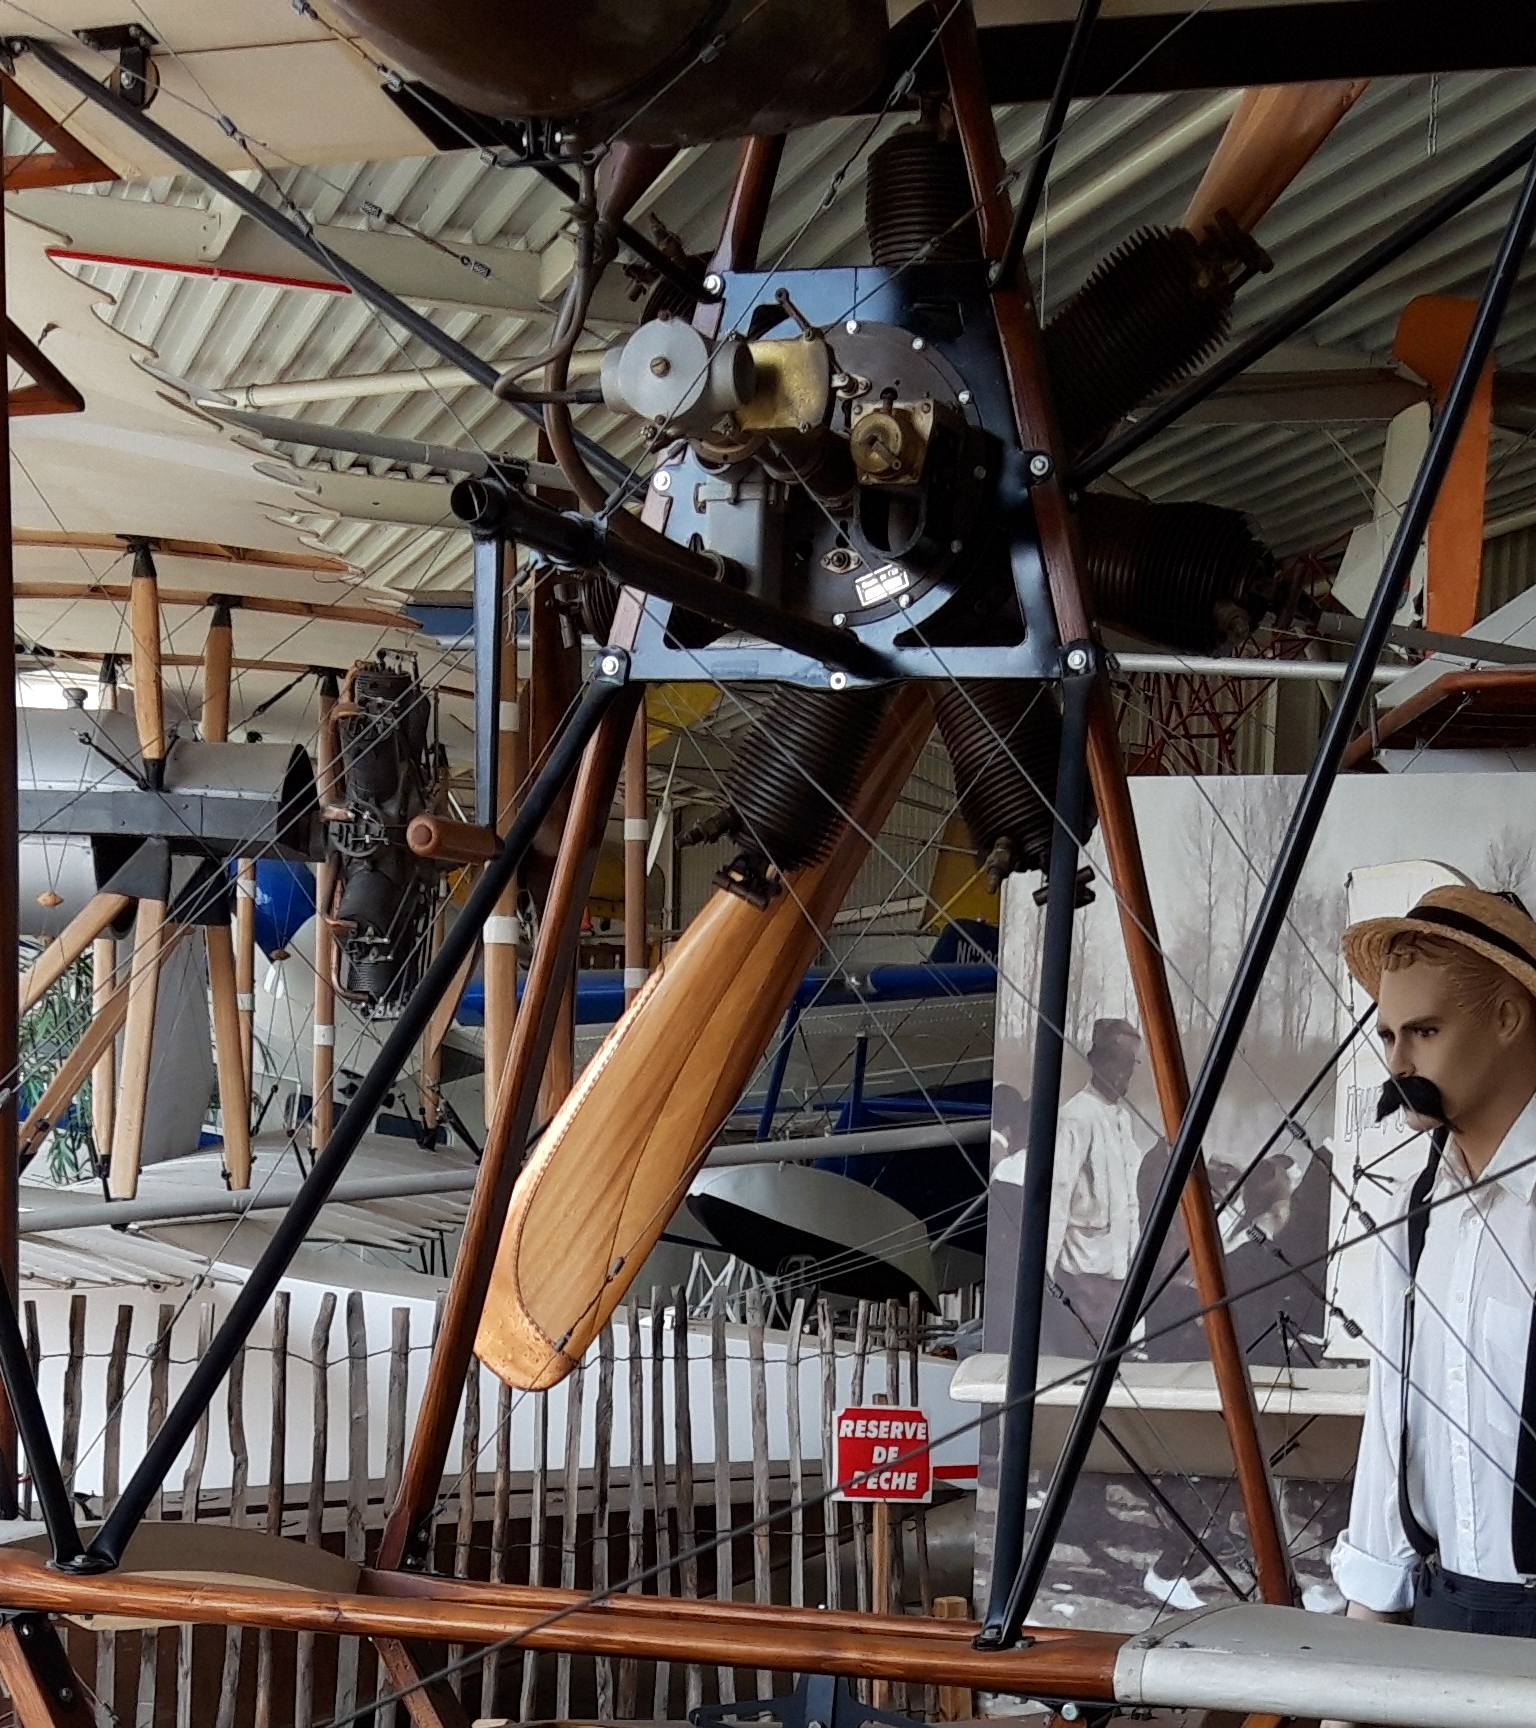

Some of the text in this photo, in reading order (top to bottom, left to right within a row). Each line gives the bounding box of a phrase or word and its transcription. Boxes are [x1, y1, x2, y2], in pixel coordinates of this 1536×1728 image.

[839, 1419, 927, 1440] RESERVE
[872, 1445, 899, 1464] DE
[851, 1470, 918, 1490] PECHE
